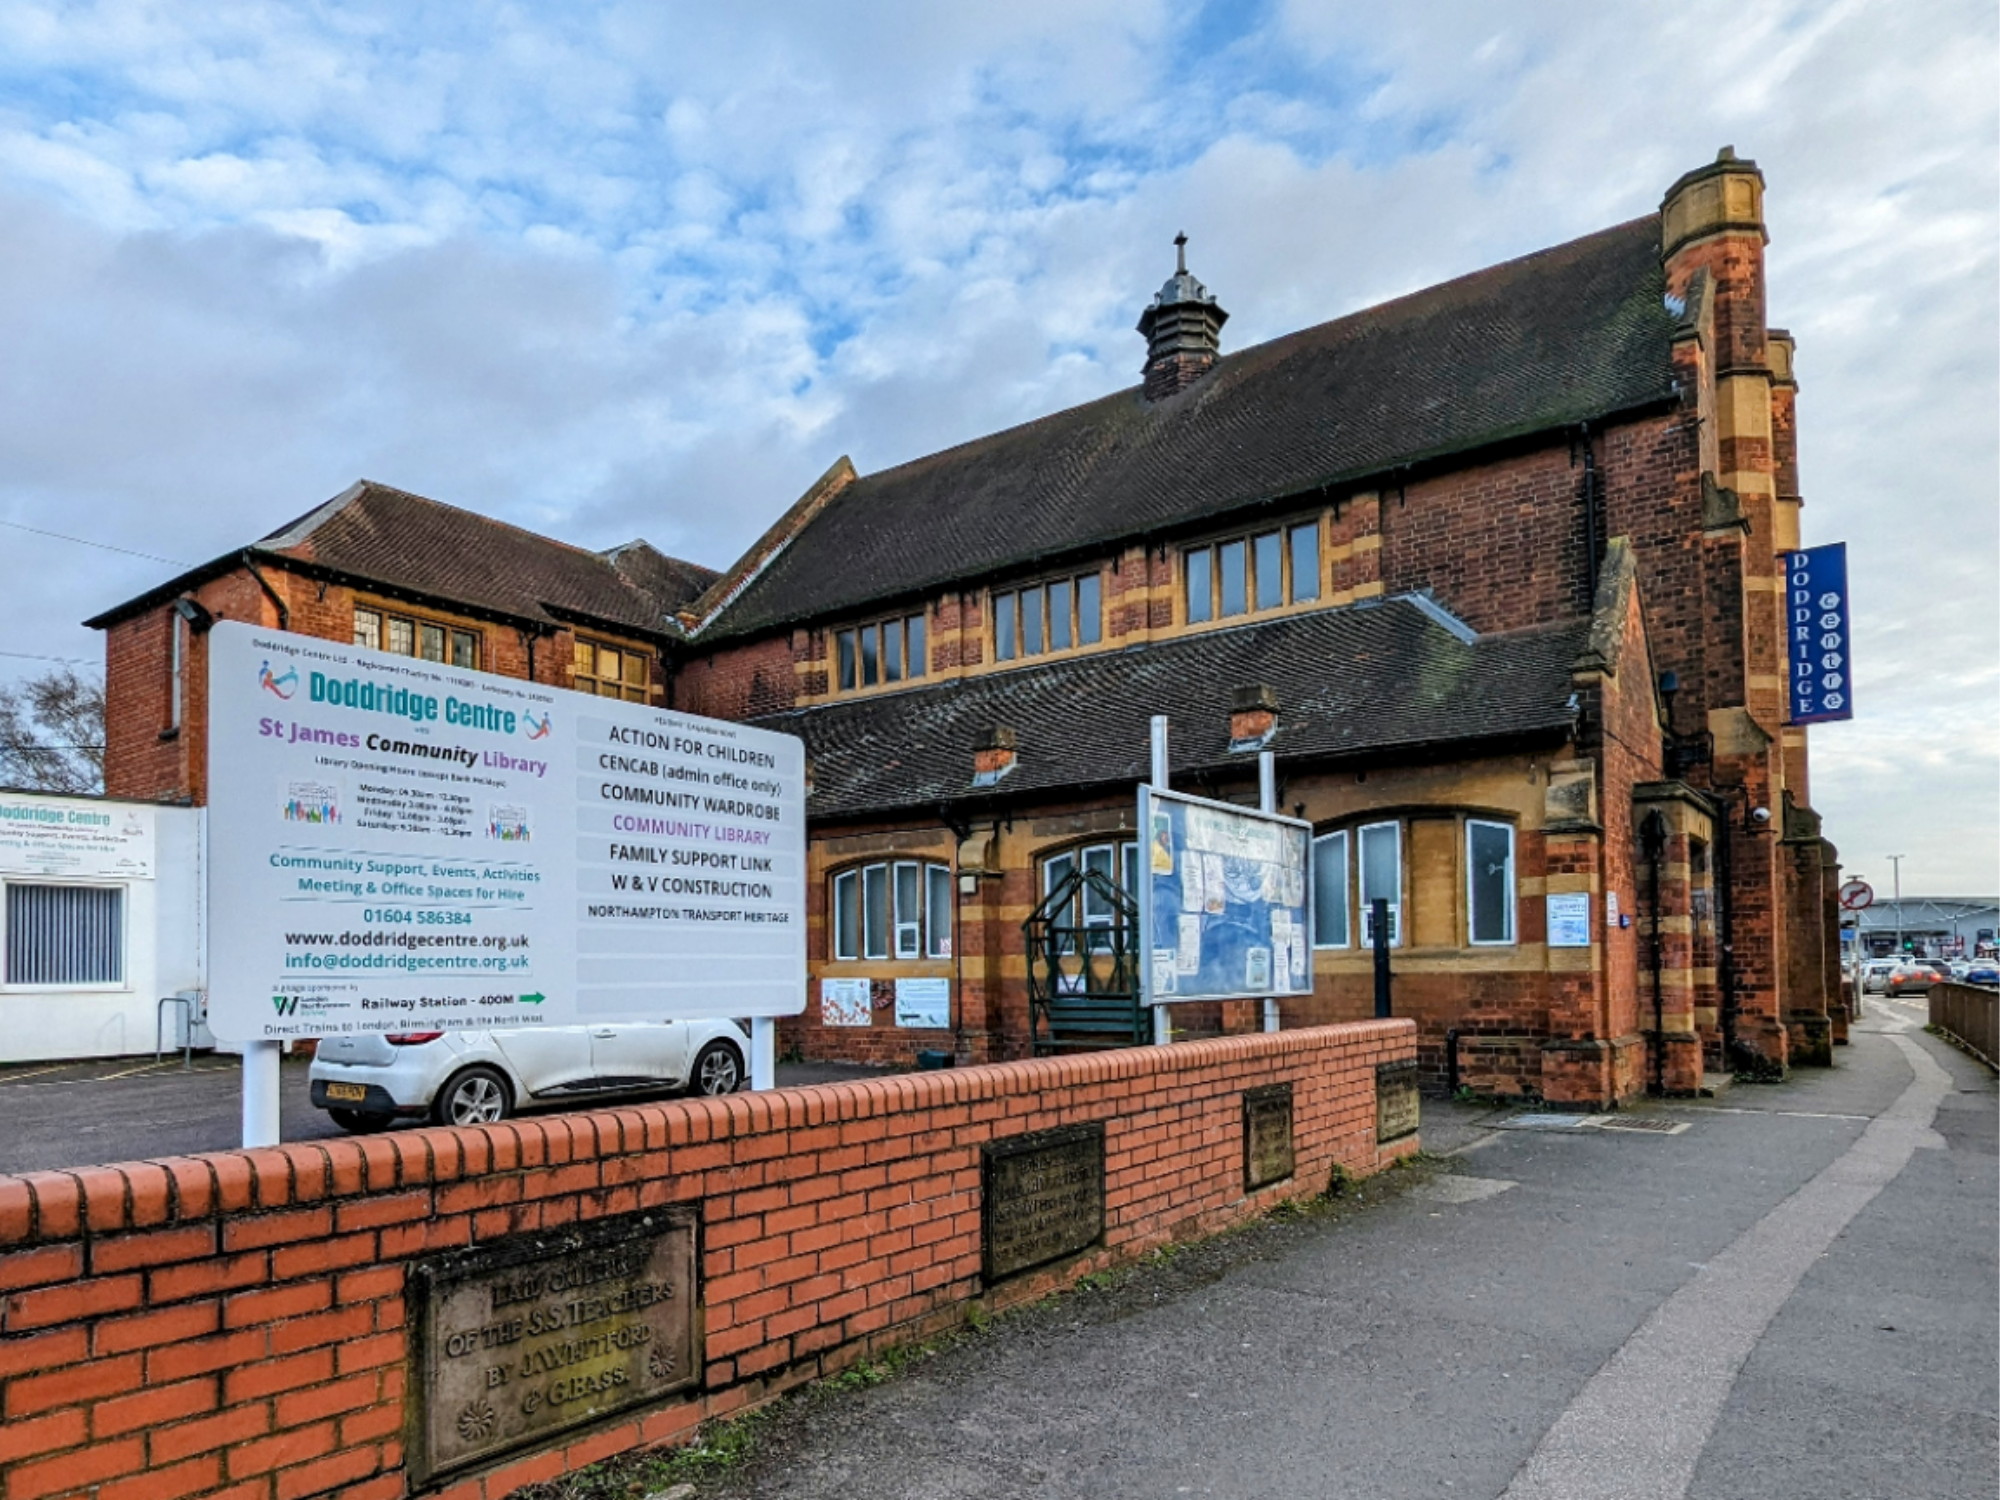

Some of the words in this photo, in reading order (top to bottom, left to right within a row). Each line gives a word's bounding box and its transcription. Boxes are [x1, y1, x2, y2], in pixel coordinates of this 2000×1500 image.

[1793, 553, 1813, 712] DODDRIDGE
[252, 638, 300, 656] Doddridge
[302, 649, 332, 661] Centre
[1824, 593, 1839, 707] centre
[310, 671, 438, 722] Doddridge
[445, 696, 516, 734] Centre
[259, 718, 284, 738] St
[288, 722, 360, 748] James
[366, 734, 478, 768] Community
[484, 751, 548, 778] Library
[609, 726, 670, 751] ACTION
[674, 737, 702, 756] FOR
[707, 744, 775, 769] CHILDREN
[315, 755, 348, 770] Library
[350, 760, 387, 774] Opening
[599, 754, 658, 776] CENCAB
[662, 764, 710, 784] (admin
[714, 771, 748, 789] office
[752, 778, 782, 797] only)
[601, 783, 700, 810] COMMUNITY
[704, 796, 780, 821] WARDROBE
[68, 809, 110, 826] Centre
[613, 815, 710, 840] COMMUNITY
[714, 828, 772, 845] LIBRARY
[270, 854, 363, 874] Community
[366, 860, 428, 876] Support,
[432, 864, 479, 879] Events,
[482, 868, 540, 882] Activities
[610, 844, 668, 864] FAMILY
[672, 850, 738, 870] SUPPORT
[740, 856, 772, 872] LINK
[298, 878, 362, 896] Meeting
[366, 882, 376, 893] &
[382, 882, 422, 896] Office
[428, 885, 472, 899] Spaces
[476, 887, 494, 899] for
[498, 888, 524, 900] Hire
[612, 874, 628, 890] W
[631, 875, 644, 892] &
[648, 876, 658, 892] V
[662, 877, 772, 898] CONSTRUCTION
[364, 909, 412, 923] 01604
[417, 910, 472, 924] 586384
[588, 905, 680, 920] NORTHAMPTON
[682, 909, 742, 922] TRANSPORT
[744, 911, 789, 924] HERITAGE
[285, 930, 530, 952] www.doddridgecentre.org.uk
[285, 952, 529, 972] info@doddridgecentre.org.uk
[362, 997, 416, 1011] Railway
[419, 996, 468, 1007] Station
[478, 994, 514, 1006] 400M
[264, 1024, 300, 1035] Direct
[302, 1022, 338, 1033] Trains
[342, 1022, 352, 1031] to
[400, 1018, 463, 1030] Birmingham
[447, 1332, 479, 1358] OF
[481, 1318, 524, 1350] THE
[567, 1280, 676, 1326] TEACHERS
